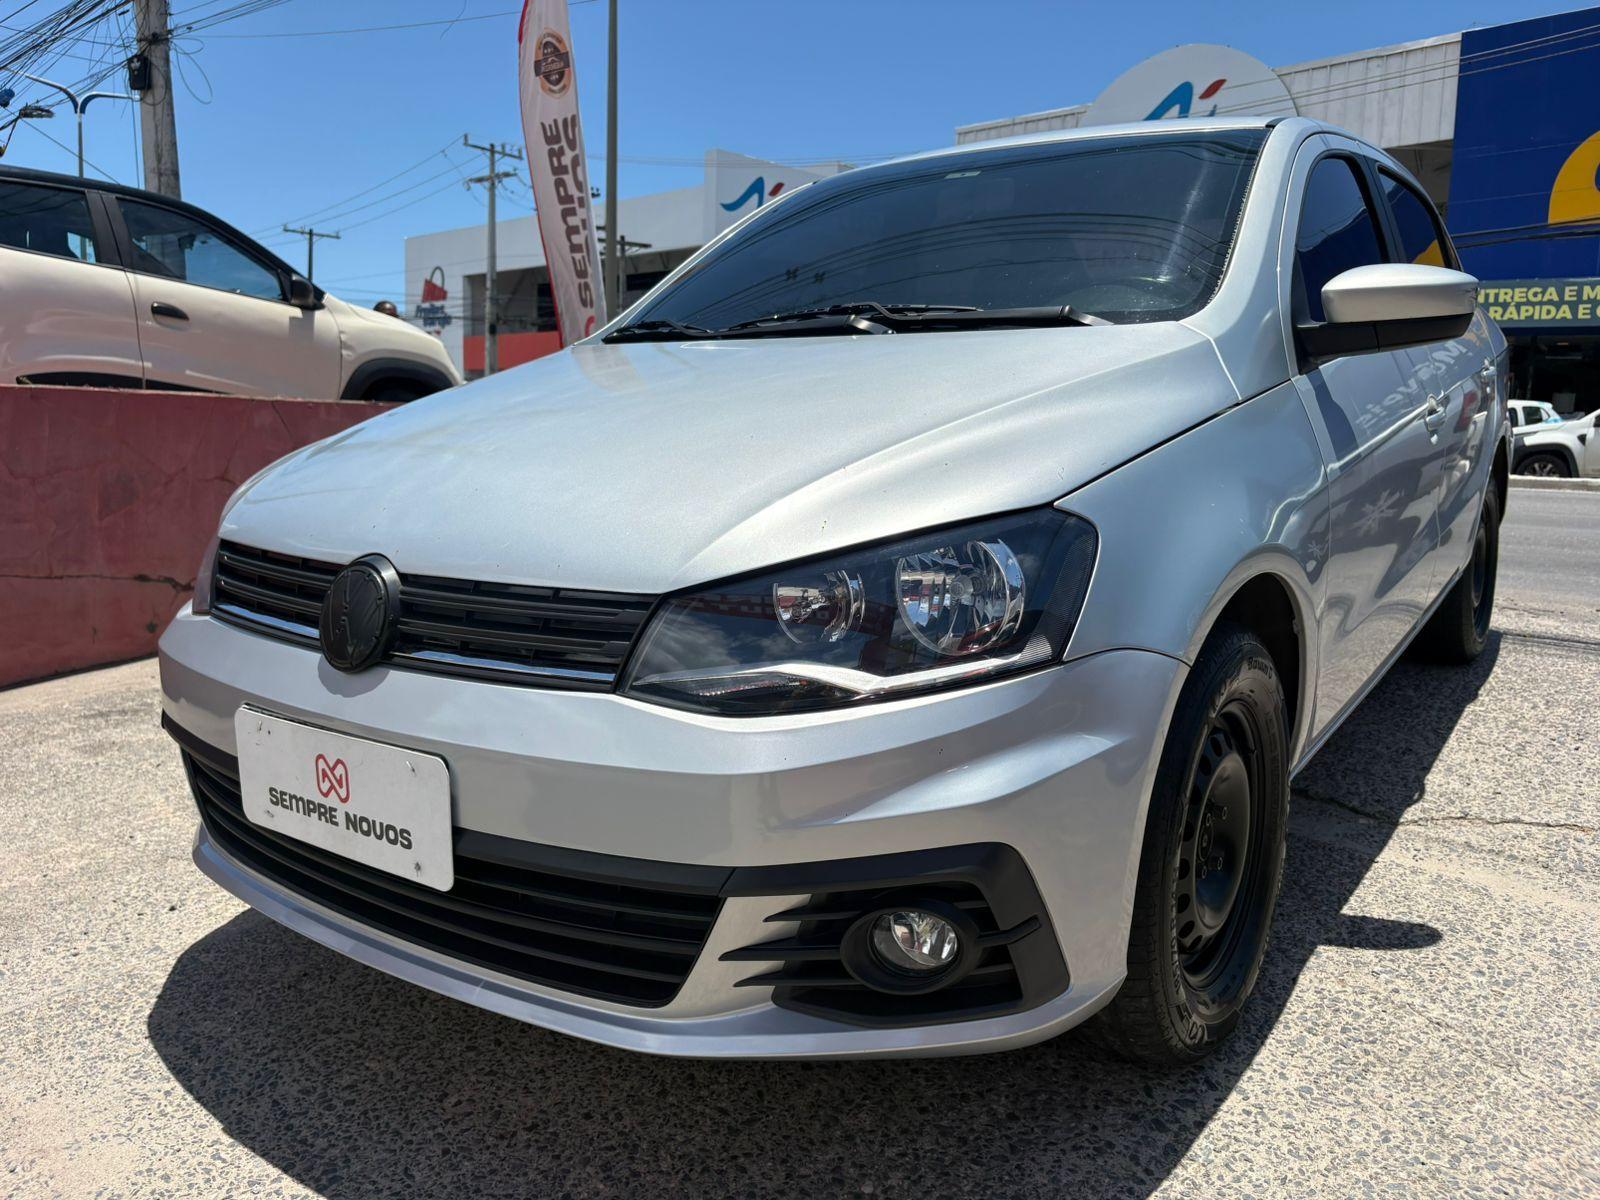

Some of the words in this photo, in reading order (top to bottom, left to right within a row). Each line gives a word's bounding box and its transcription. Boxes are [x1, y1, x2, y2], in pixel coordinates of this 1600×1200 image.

[541, 117, 594, 309] SEMPRE
[1489, 301, 1572, 320] RÁPIDA
[1577, 304, 1592, 319] E
[1564, 286, 1578, 301] E
[269, 786, 339, 827] SEMPRE
[345, 811, 413, 850] NOVOS
